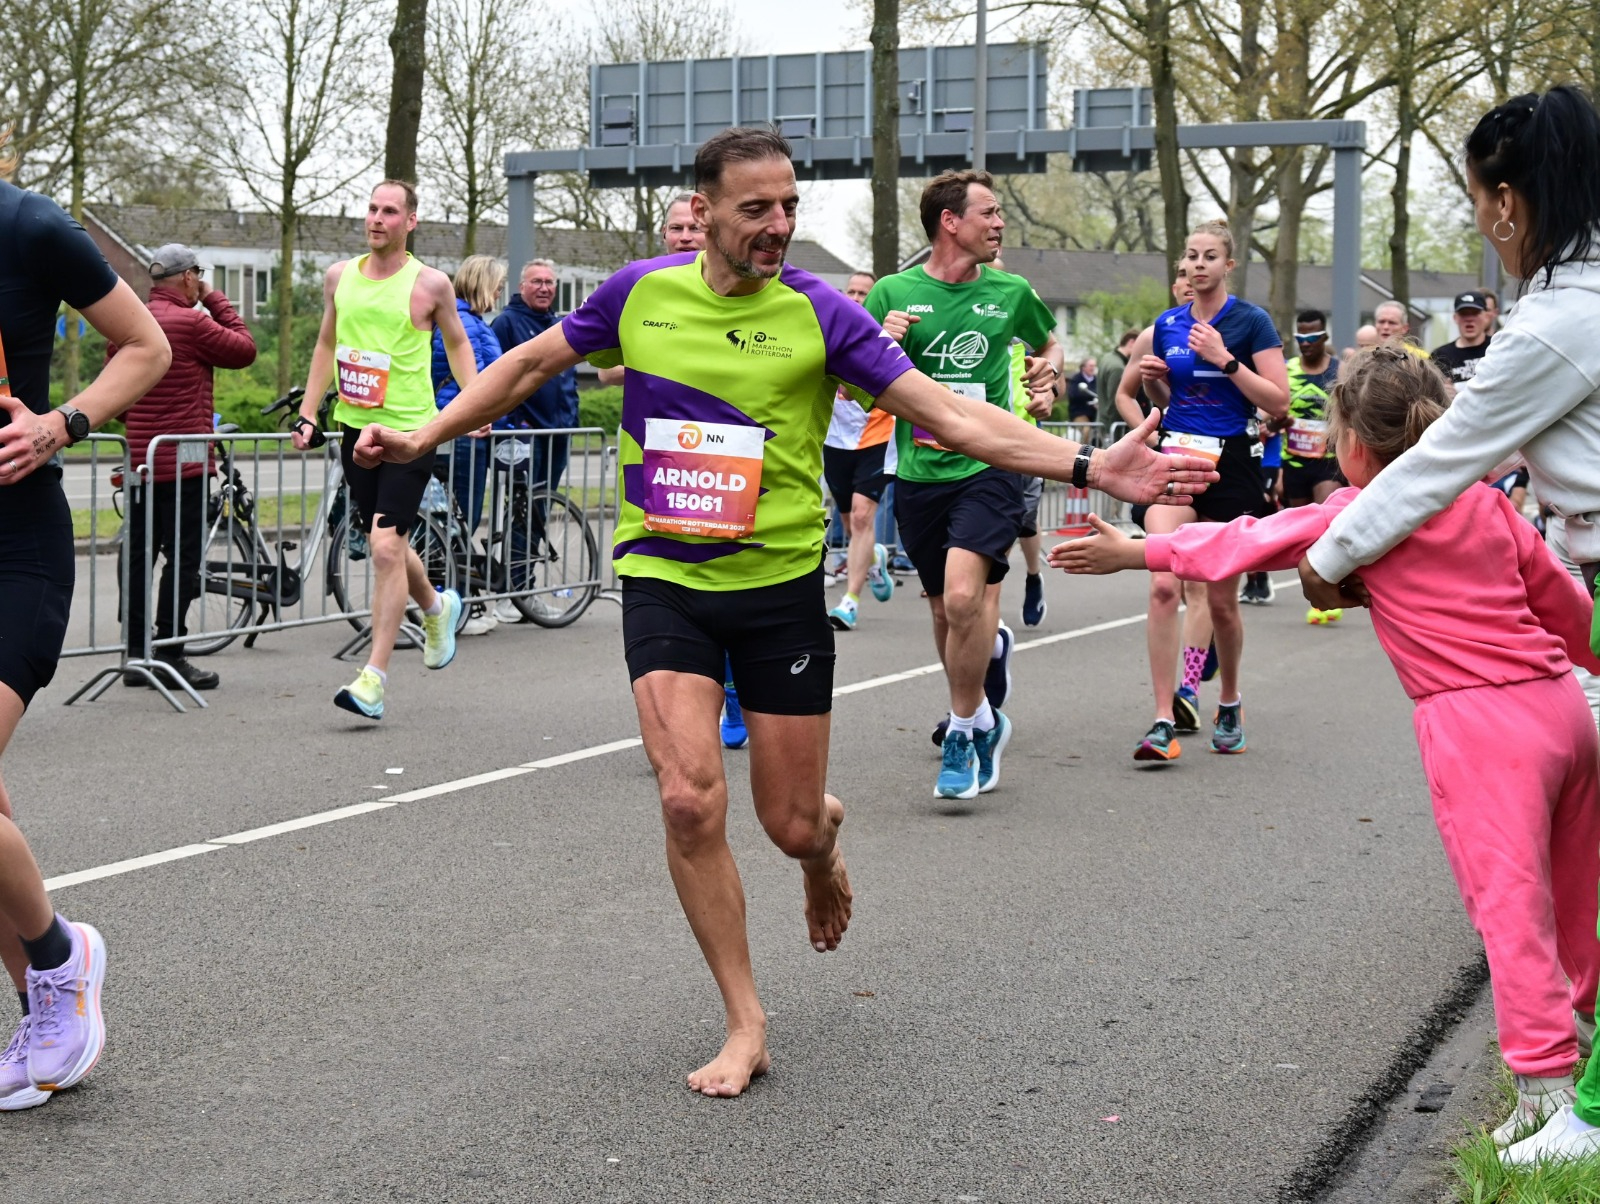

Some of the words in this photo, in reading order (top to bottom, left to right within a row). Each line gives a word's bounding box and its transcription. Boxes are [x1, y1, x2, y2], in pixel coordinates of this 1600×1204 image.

[906, 304, 935, 313] HOKA
[642, 320, 670, 330] CRAFT
[750, 349, 792, 359] ROTTERDAM
[752, 343, 793, 353] MARATHON
[340, 367, 381, 388] MARK
[343, 382, 370, 396] 19849
[706, 433, 725, 444] NN
[652, 467, 747, 492] ARNOLD
[666, 492, 723, 513] 15061
[655, 517, 687, 526] MARATHON
[688, 520, 729, 530] ROTTERDAM
